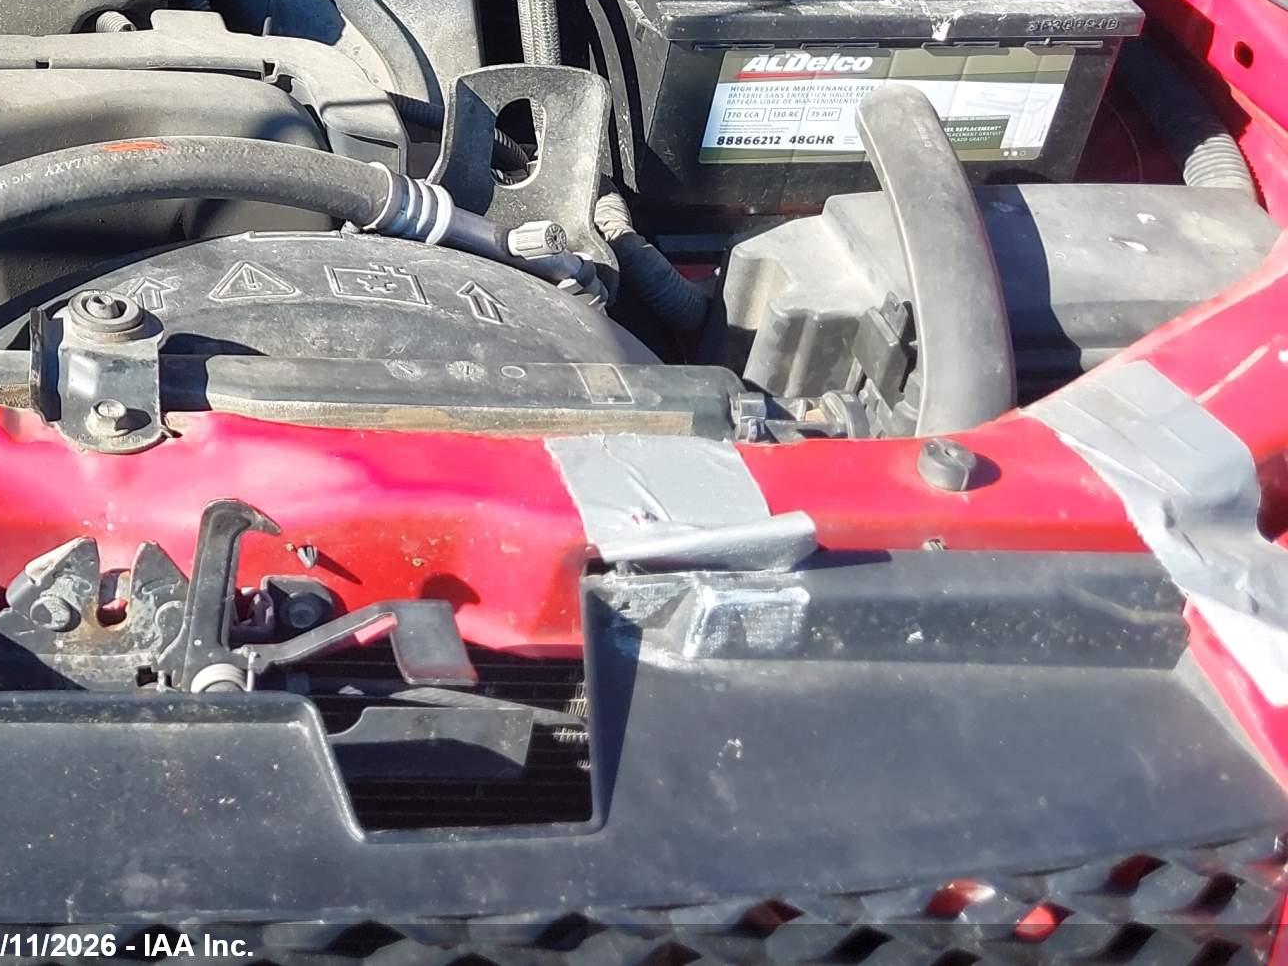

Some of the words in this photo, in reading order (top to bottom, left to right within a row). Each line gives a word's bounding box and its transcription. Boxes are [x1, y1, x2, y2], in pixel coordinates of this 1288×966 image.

[742, 52, 874, 73] ACDelco
[730, 85, 752, 93] HIGH
[727, 111, 742, 119] 770
[716, 135, 782, 146] 88866212
[788, 135, 835, 145] 48GHR
[11, 171, 32, 184] A/C
